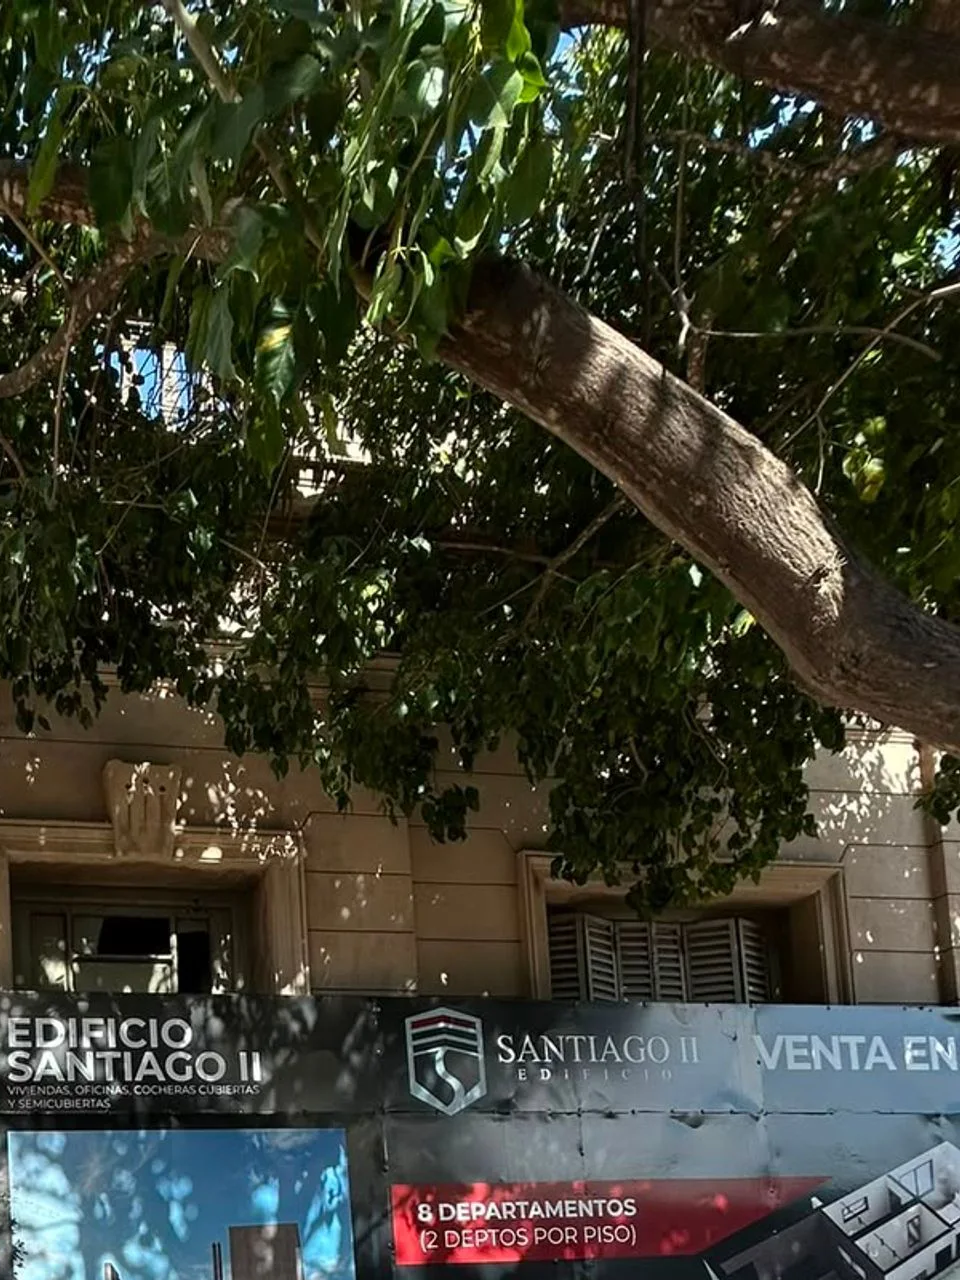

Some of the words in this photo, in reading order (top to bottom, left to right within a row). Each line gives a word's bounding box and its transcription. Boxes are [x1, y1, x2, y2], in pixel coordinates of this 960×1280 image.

[7, 1018, 192, 1048] EDIFICIO
[497, 1035, 670, 1063] SANTIAGO
[681, 1036, 700, 1063] II
[754, 1034, 897, 1071] VENTA
[903, 1036, 959, 1071] EN
[7, 1051, 226, 1083] SANTIAGO
[240, 1052, 262, 1082] II
[518, 1068, 673, 1081] EDIFICIO
[7, 1085, 73, 1096] VIVIENDAS,
[133, 1085, 197, 1096] COCHERAS
[198, 1085, 260, 1095] CUBIERTAS
[8, 1099, 16, 1108] Y
[18, 1098, 111, 1109] SEMICUBIERTAS
[417, 1204, 433, 1222] 8
[439, 1199, 637, 1221] DEPARTAMENTOS
[420, 1231, 438, 1253] (2
[445, 1228, 528, 1248] DEPTOS
[534, 1227, 578, 1245] POR
[584, 1224, 637, 1246] PISO)
